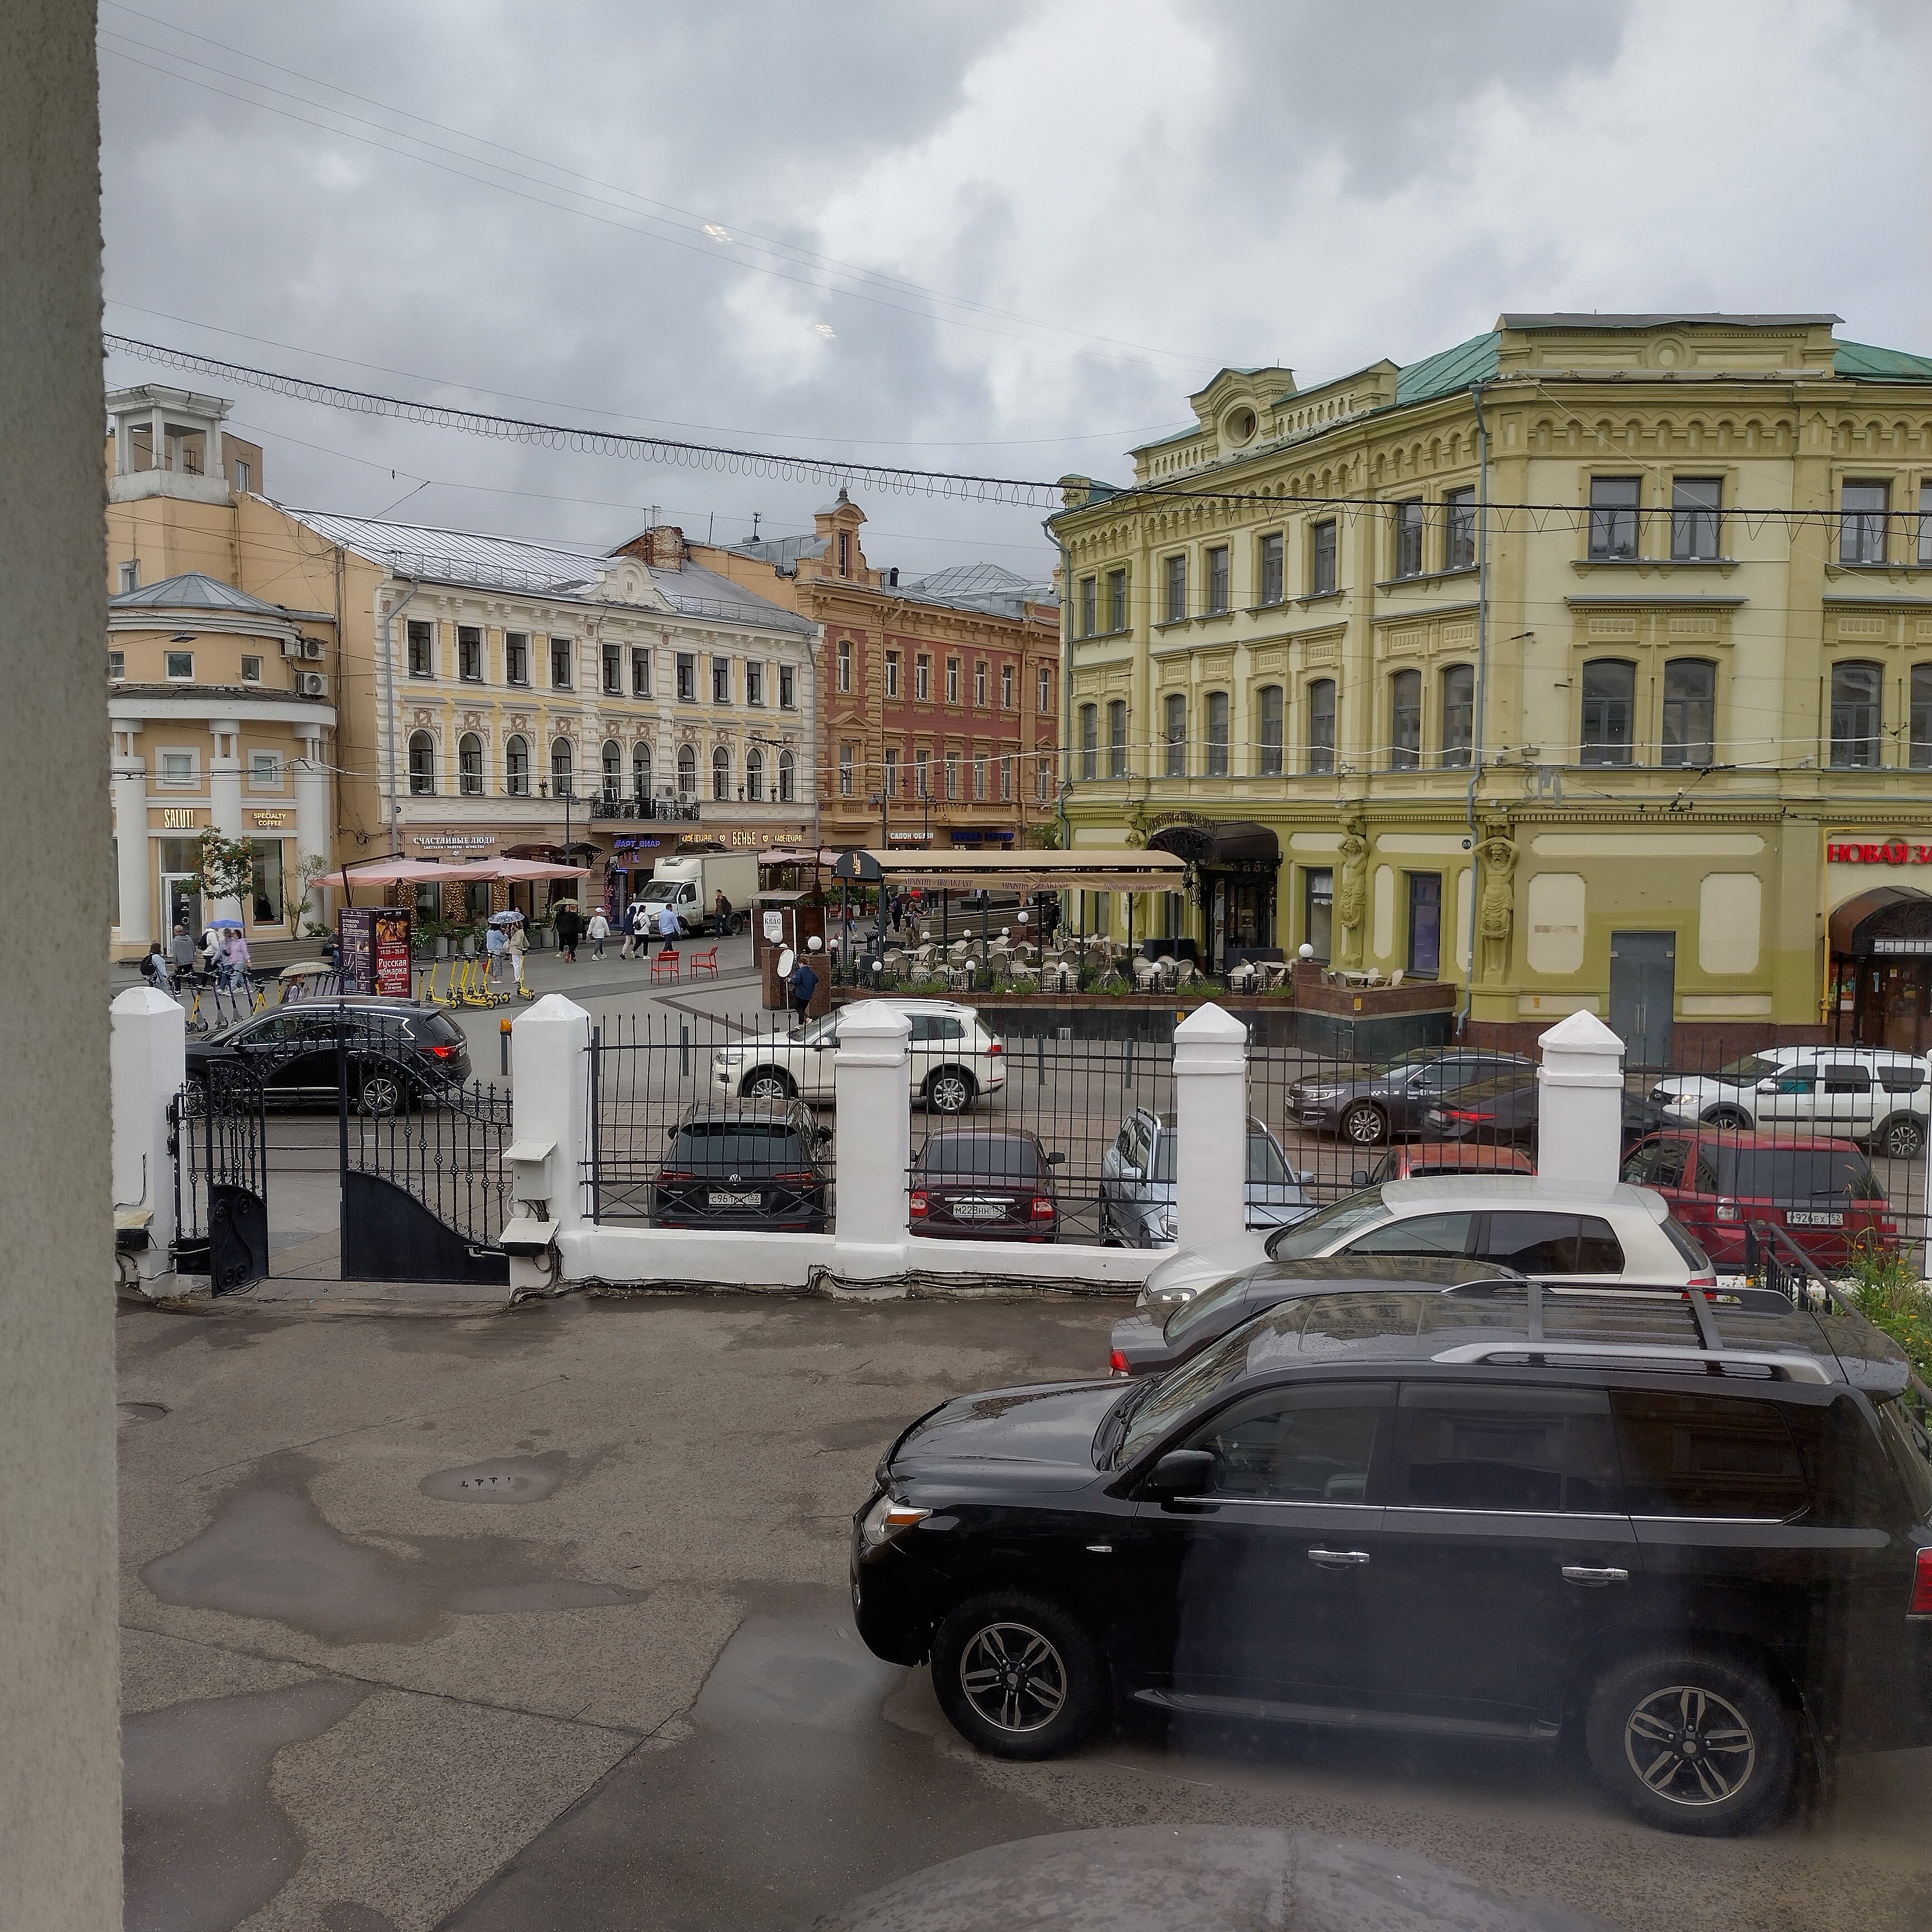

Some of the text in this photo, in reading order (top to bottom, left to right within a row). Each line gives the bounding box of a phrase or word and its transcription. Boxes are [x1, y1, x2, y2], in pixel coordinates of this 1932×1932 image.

[164, 809, 194, 829] SALUT!
[471, 836, 495, 845] ЛЮДИ
[732, 832, 756, 845] БЕНЬЕ
[1828, 844, 1908, 864] НОВАЯ
[905, 878, 973, 887] MINISTRY BREAKFAST
[1002, 882, 1029, 890] MINISTRY
[378, 958, 407, 969] Русская
[378, 968, 407, 979] ярмарка
